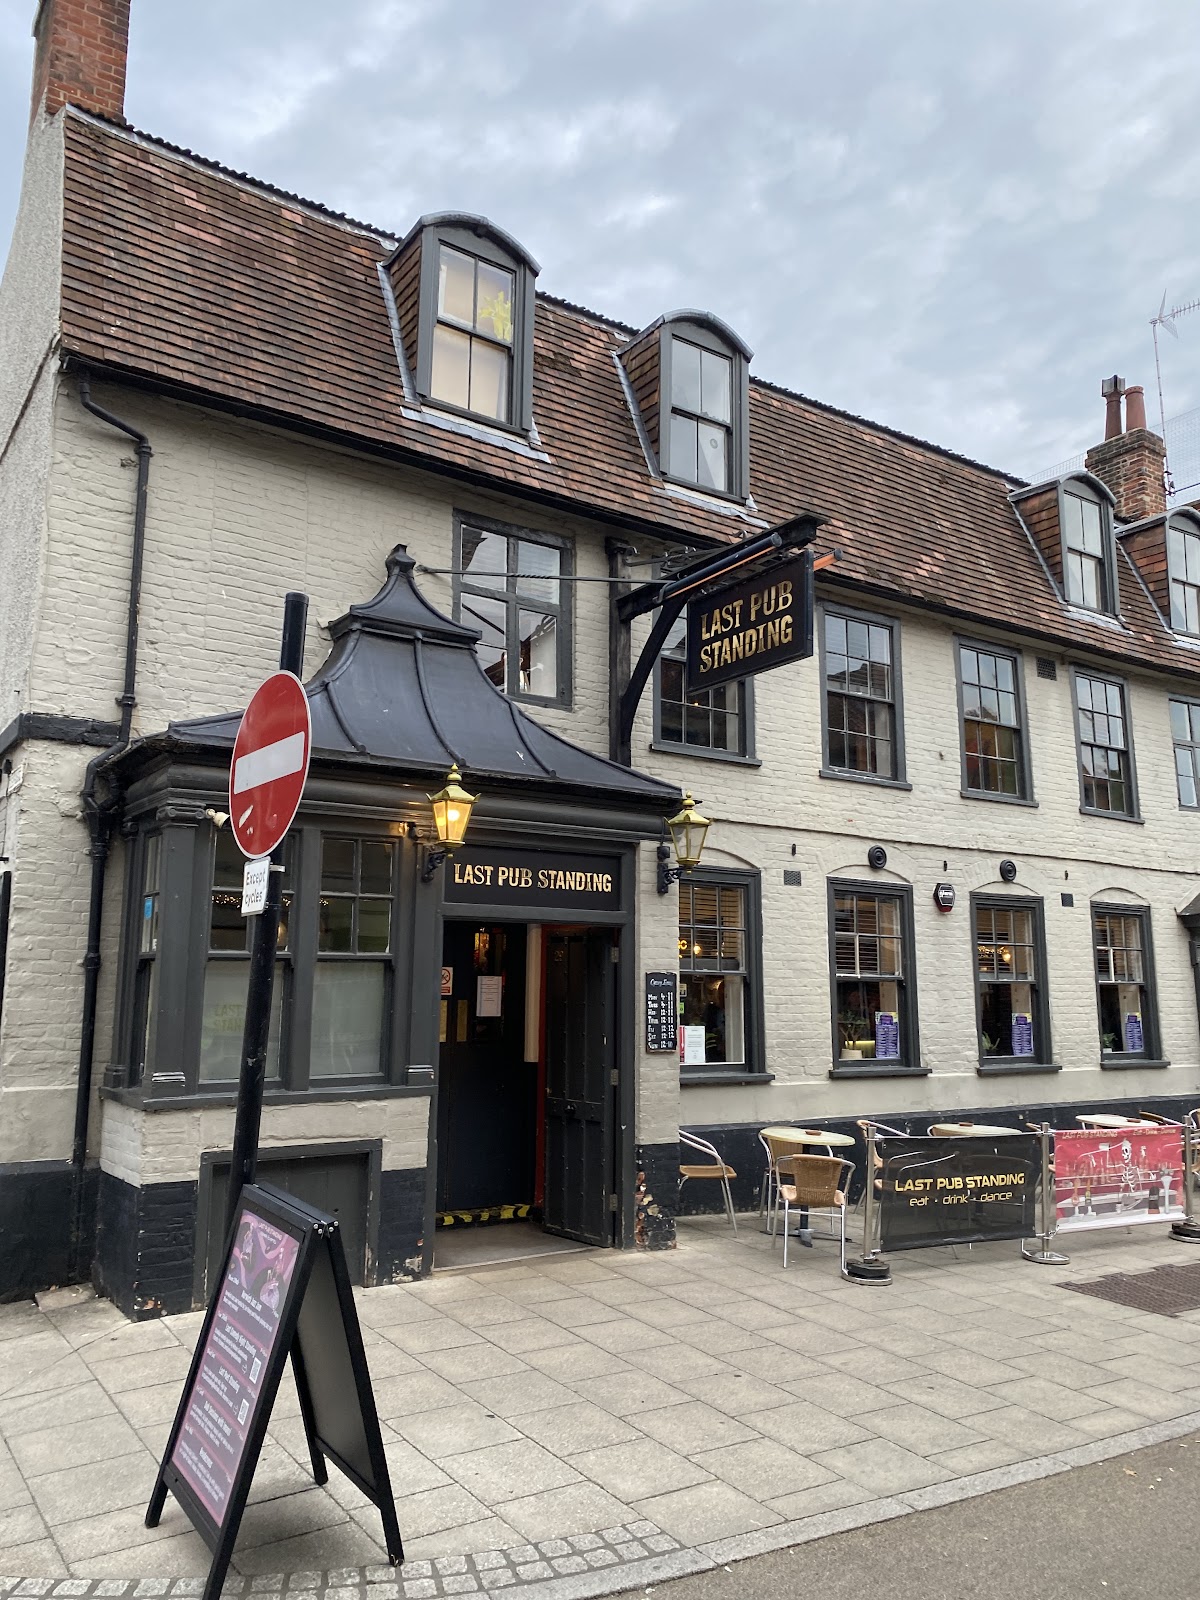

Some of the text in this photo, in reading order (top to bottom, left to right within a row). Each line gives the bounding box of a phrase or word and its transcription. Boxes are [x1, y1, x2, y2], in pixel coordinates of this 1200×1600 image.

[700, 580, 793, 640] LAST PUB
[700, 614, 793, 673] STANDING
[246, 868, 266, 886] Except
[454, 863, 612, 893] LAST PUB STANDING
[245, 889, 262, 907] cycles
[895, 1172, 1025, 1192] LAST PUB STANDING
[910, 1191, 1012, 1206] eat drink dance
